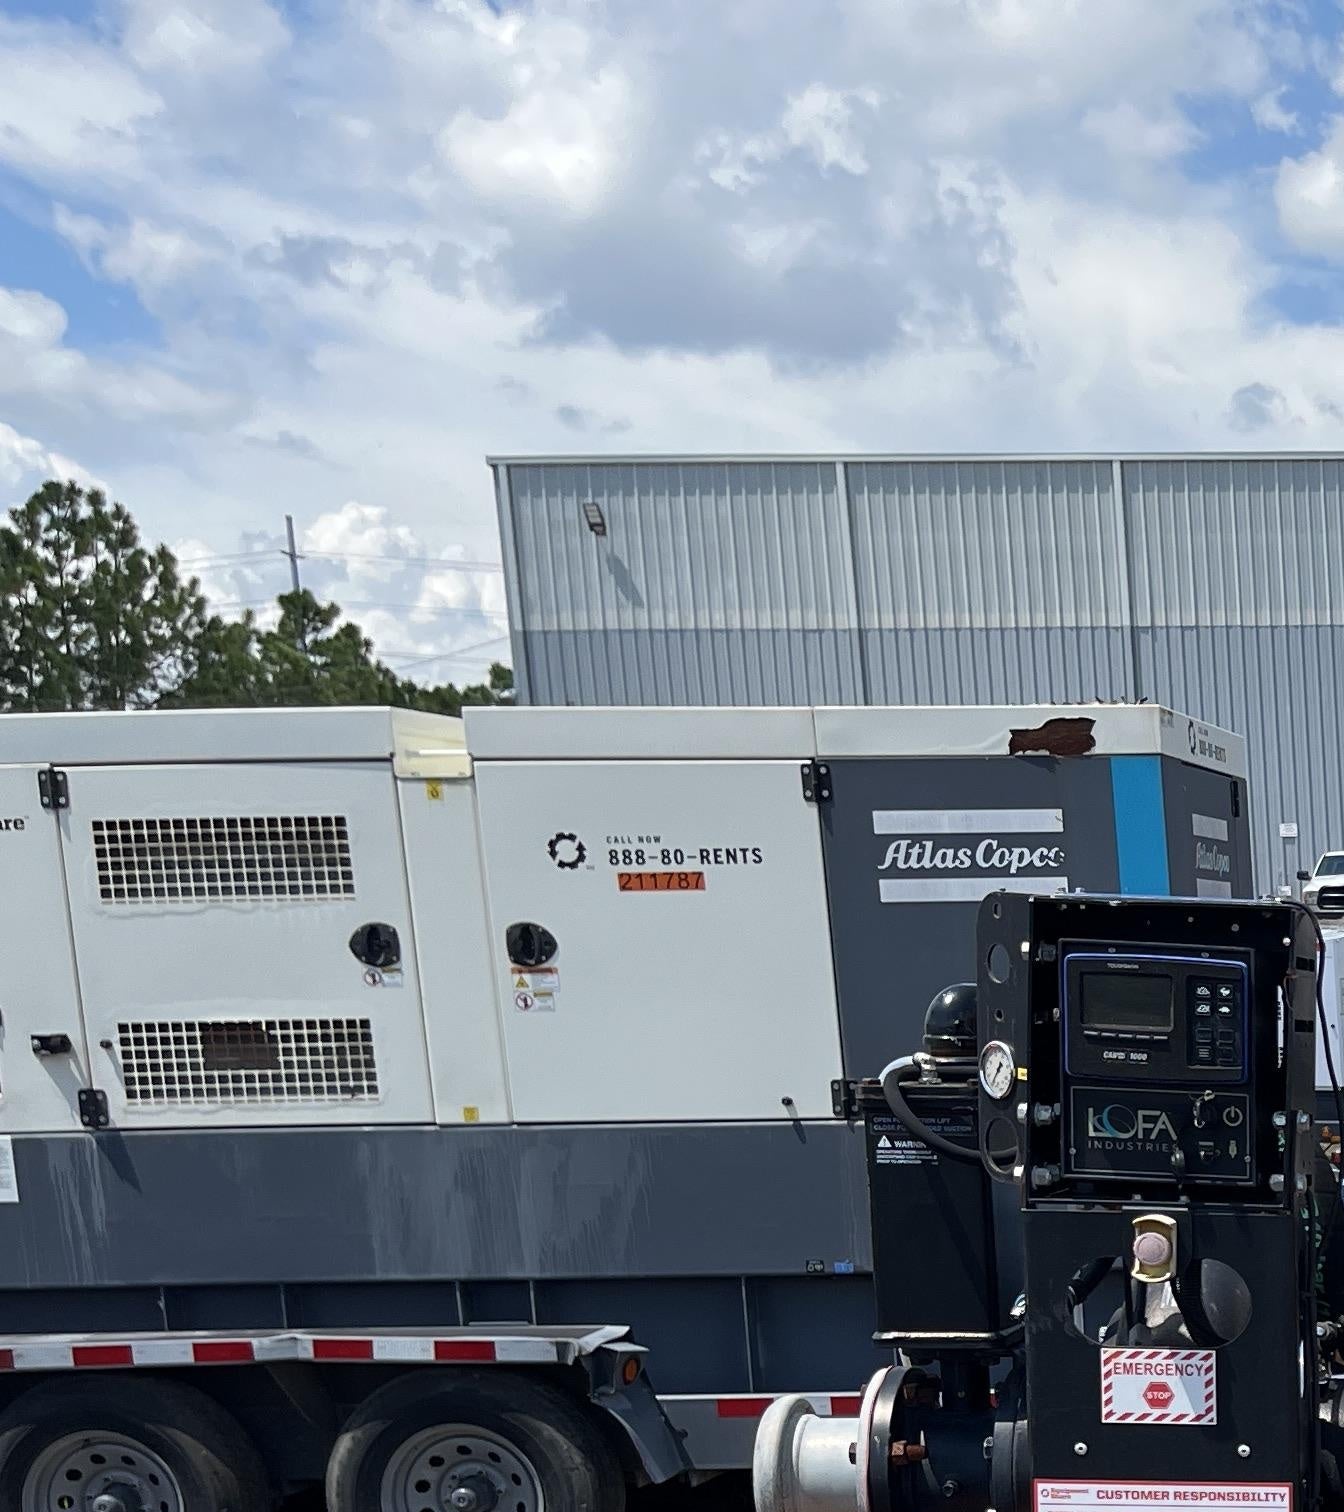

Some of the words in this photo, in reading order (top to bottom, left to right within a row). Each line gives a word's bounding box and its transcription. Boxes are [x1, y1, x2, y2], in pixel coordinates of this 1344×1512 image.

[606, 836, 632, 844] CALL
[638, 836, 661, 844] NOW
[608, 848, 763, 866] 888-80-RENTS
[878, 840, 972, 869] Atlas
[619, 873, 704, 890] 211787
[1088, 1104, 1178, 1141] LOFA
[1088, 1140, 1178, 1152] INDUSTRIES
[1113, 1362, 1203, 1376] EMERGENCY
[1147, 1391, 1171, 1400] STOP
[1096, 1490, 1170, 1500] CUSTOMER
[1174, 1491, 1286, 1502] RESPONSIBILITY
